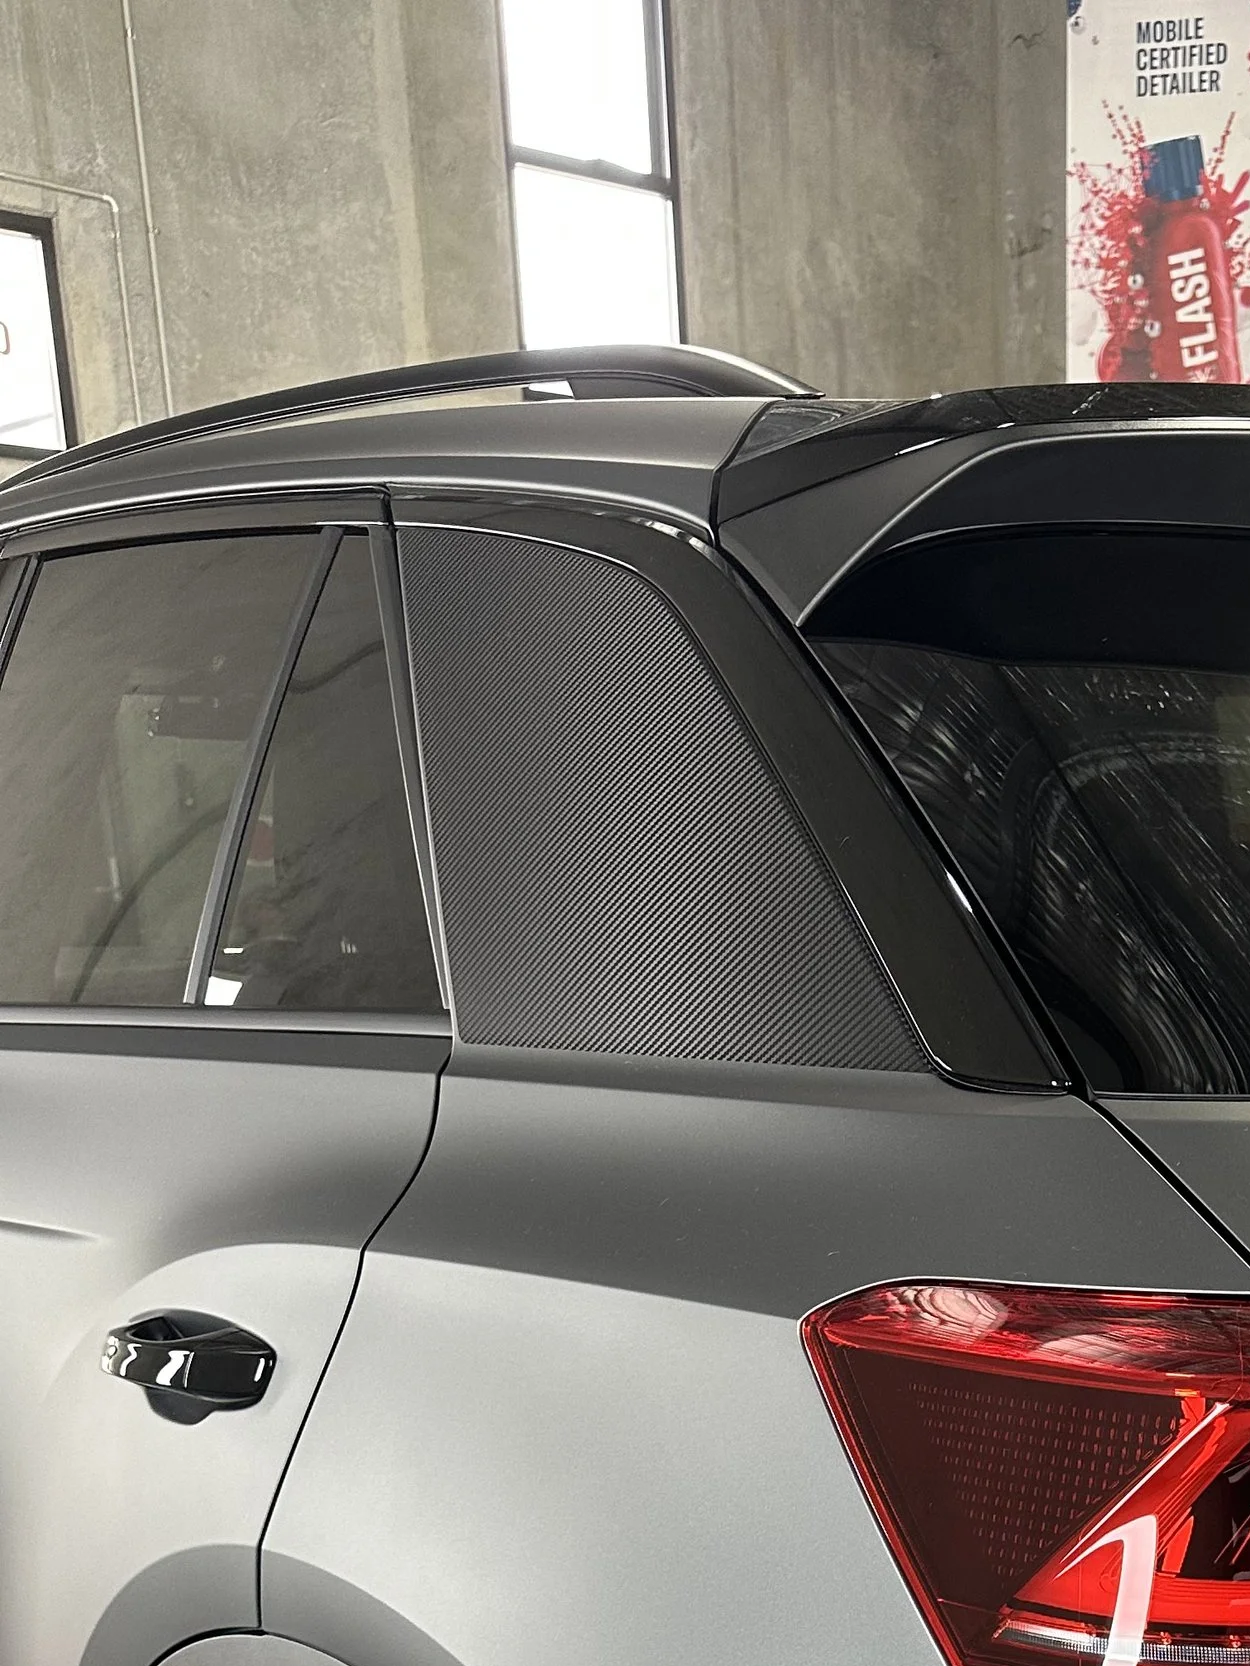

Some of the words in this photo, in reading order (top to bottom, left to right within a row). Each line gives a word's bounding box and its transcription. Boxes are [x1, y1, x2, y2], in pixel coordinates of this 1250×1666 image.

[1136, 17, 1205, 44] MOBILE
[1136, 43, 1228, 71] CERTIFIED
[1136, 70, 1222, 98] DETAILER
[1167, 247, 1219, 368] FLASH
